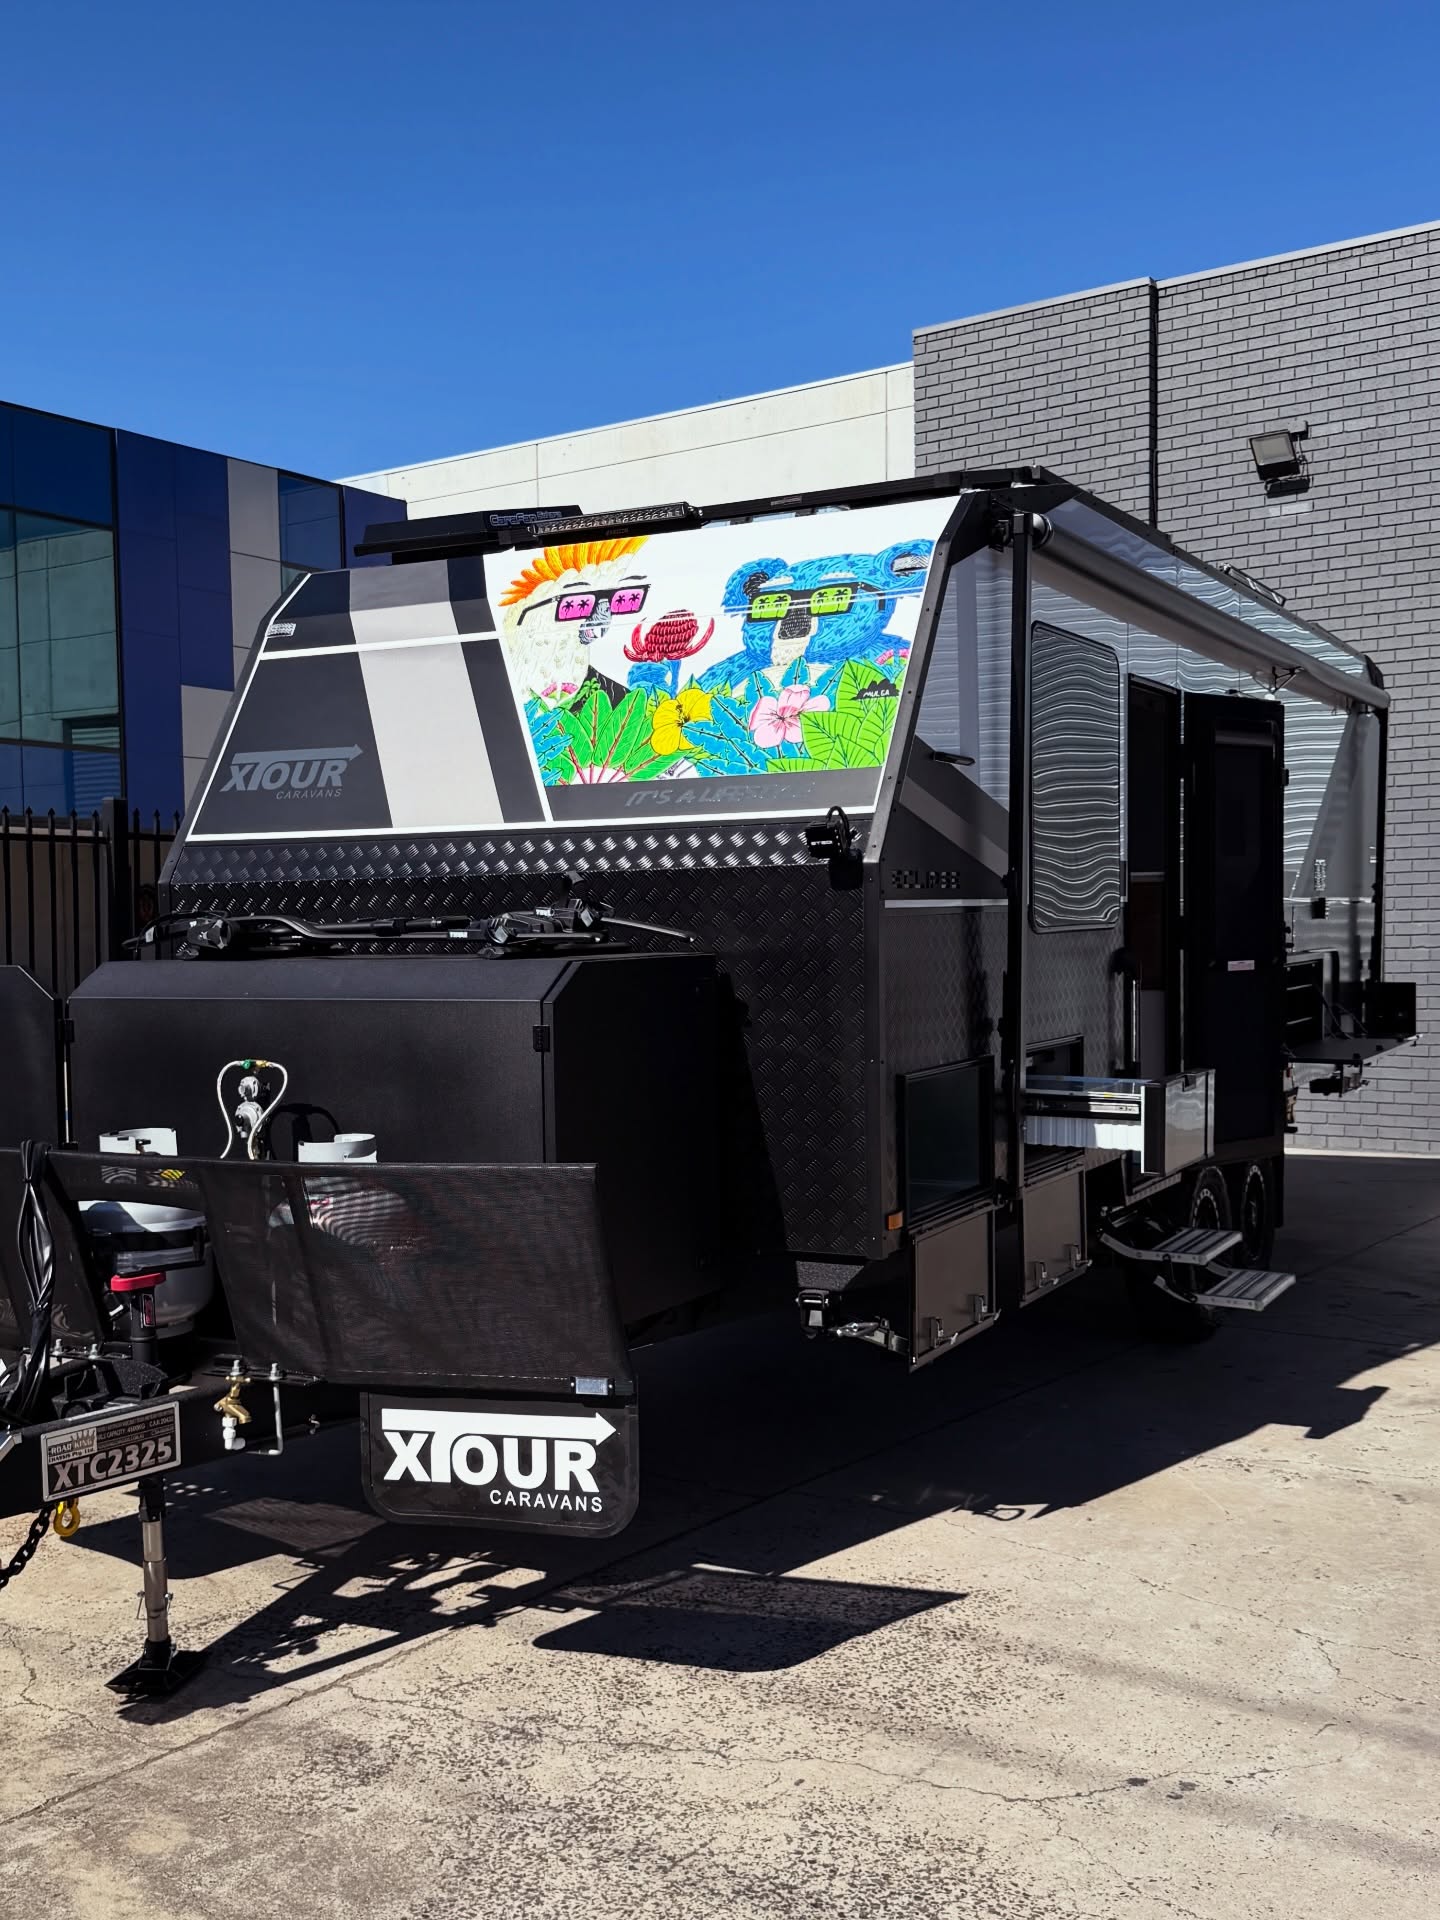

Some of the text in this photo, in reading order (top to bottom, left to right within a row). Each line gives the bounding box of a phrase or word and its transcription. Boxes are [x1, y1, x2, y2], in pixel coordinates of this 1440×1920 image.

[219, 743, 363, 793] XTOUR
[275, 788, 343, 800] CARAVANS
[624, 789, 673, 808] IT'S
[675, 788, 697, 804] A
[890, 869, 961, 889] ECLIPSE
[381, 1408, 617, 1494] XTOUR
[54, 1436, 172, 1492] XTC2325
[489, 1489, 603, 1513] CARAVANS
